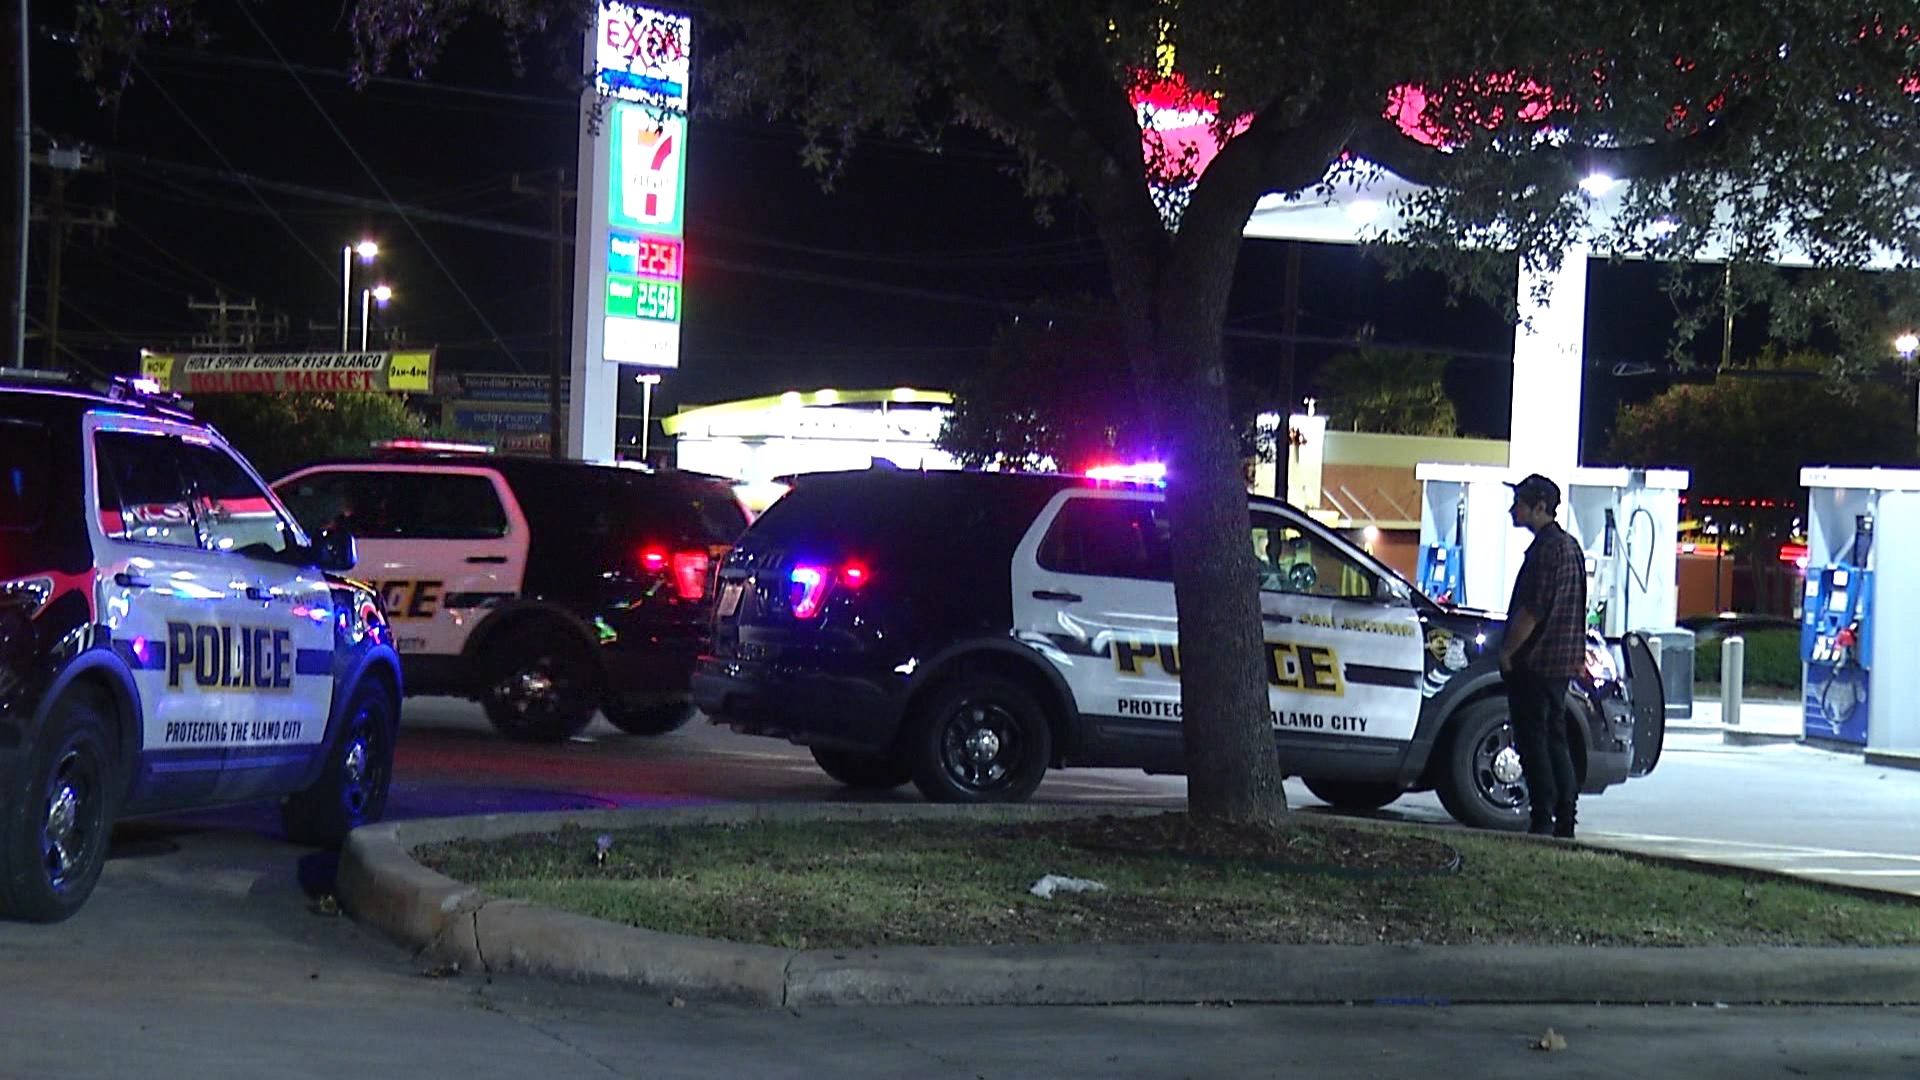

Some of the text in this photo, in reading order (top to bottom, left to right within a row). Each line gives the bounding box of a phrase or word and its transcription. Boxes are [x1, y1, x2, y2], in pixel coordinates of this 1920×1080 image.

[188, 356, 213, 370] HOLY
[215, 356, 251, 369] SPIRIT
[254, 355, 302, 369] CHURCH
[333, 354, 382, 368] BLANCO
[190, 369, 375, 393] HOLIDAY MARKET
[166, 620, 294, 694] POLICE
[165, 720, 304, 743] PROTECTING THE ALAMO CITY
[1331, 715, 1368, 733] CITY
